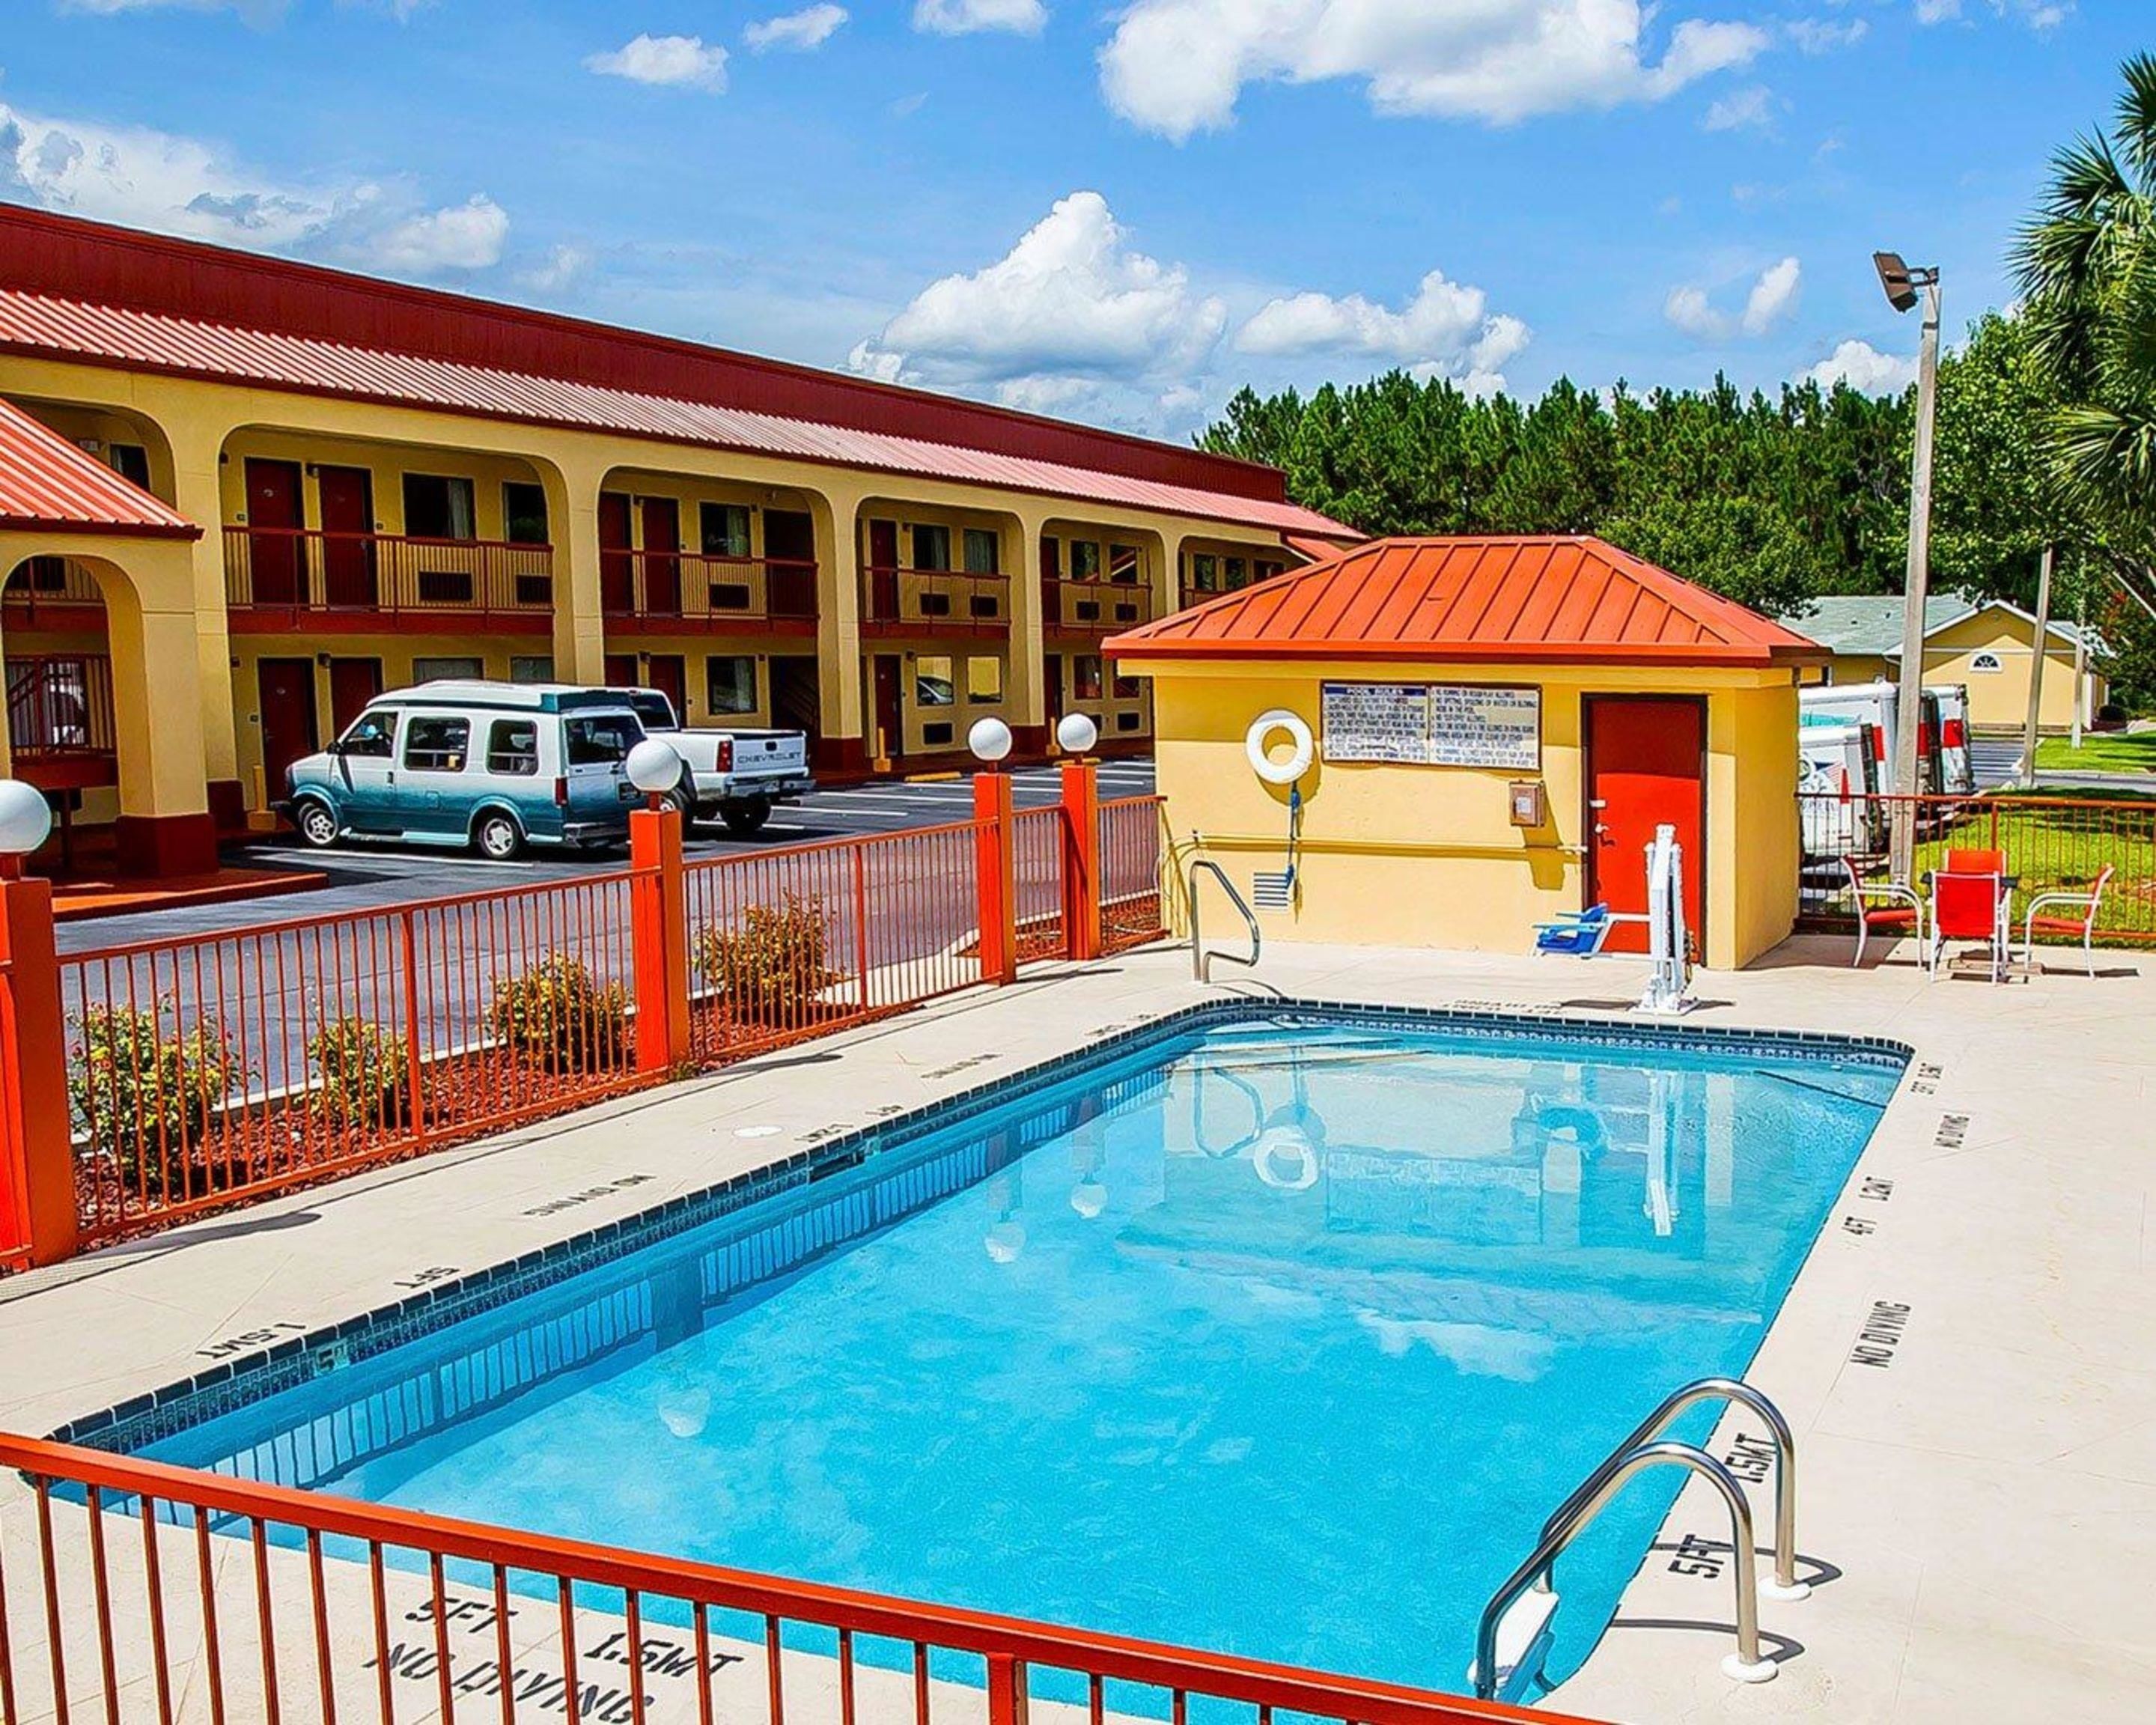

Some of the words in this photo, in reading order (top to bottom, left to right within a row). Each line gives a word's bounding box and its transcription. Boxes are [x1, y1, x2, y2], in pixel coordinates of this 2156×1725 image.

[737, 752, 801, 764] CHEVROLET
[611, 1174, 657, 1187] NO
[523, 1186, 621, 1216] DIVING
[393, 1266, 460, 1289] 5FT
[1860, 1300, 1911, 1345] DIVING
[1849, 1345, 1894, 1369] NO
[1667, 1534, 1736, 1579] 5FT
[405, 1598, 519, 1634] 5FT
[362, 1643, 456, 1680] NO
[451, 1661, 655, 1724] DIVING
